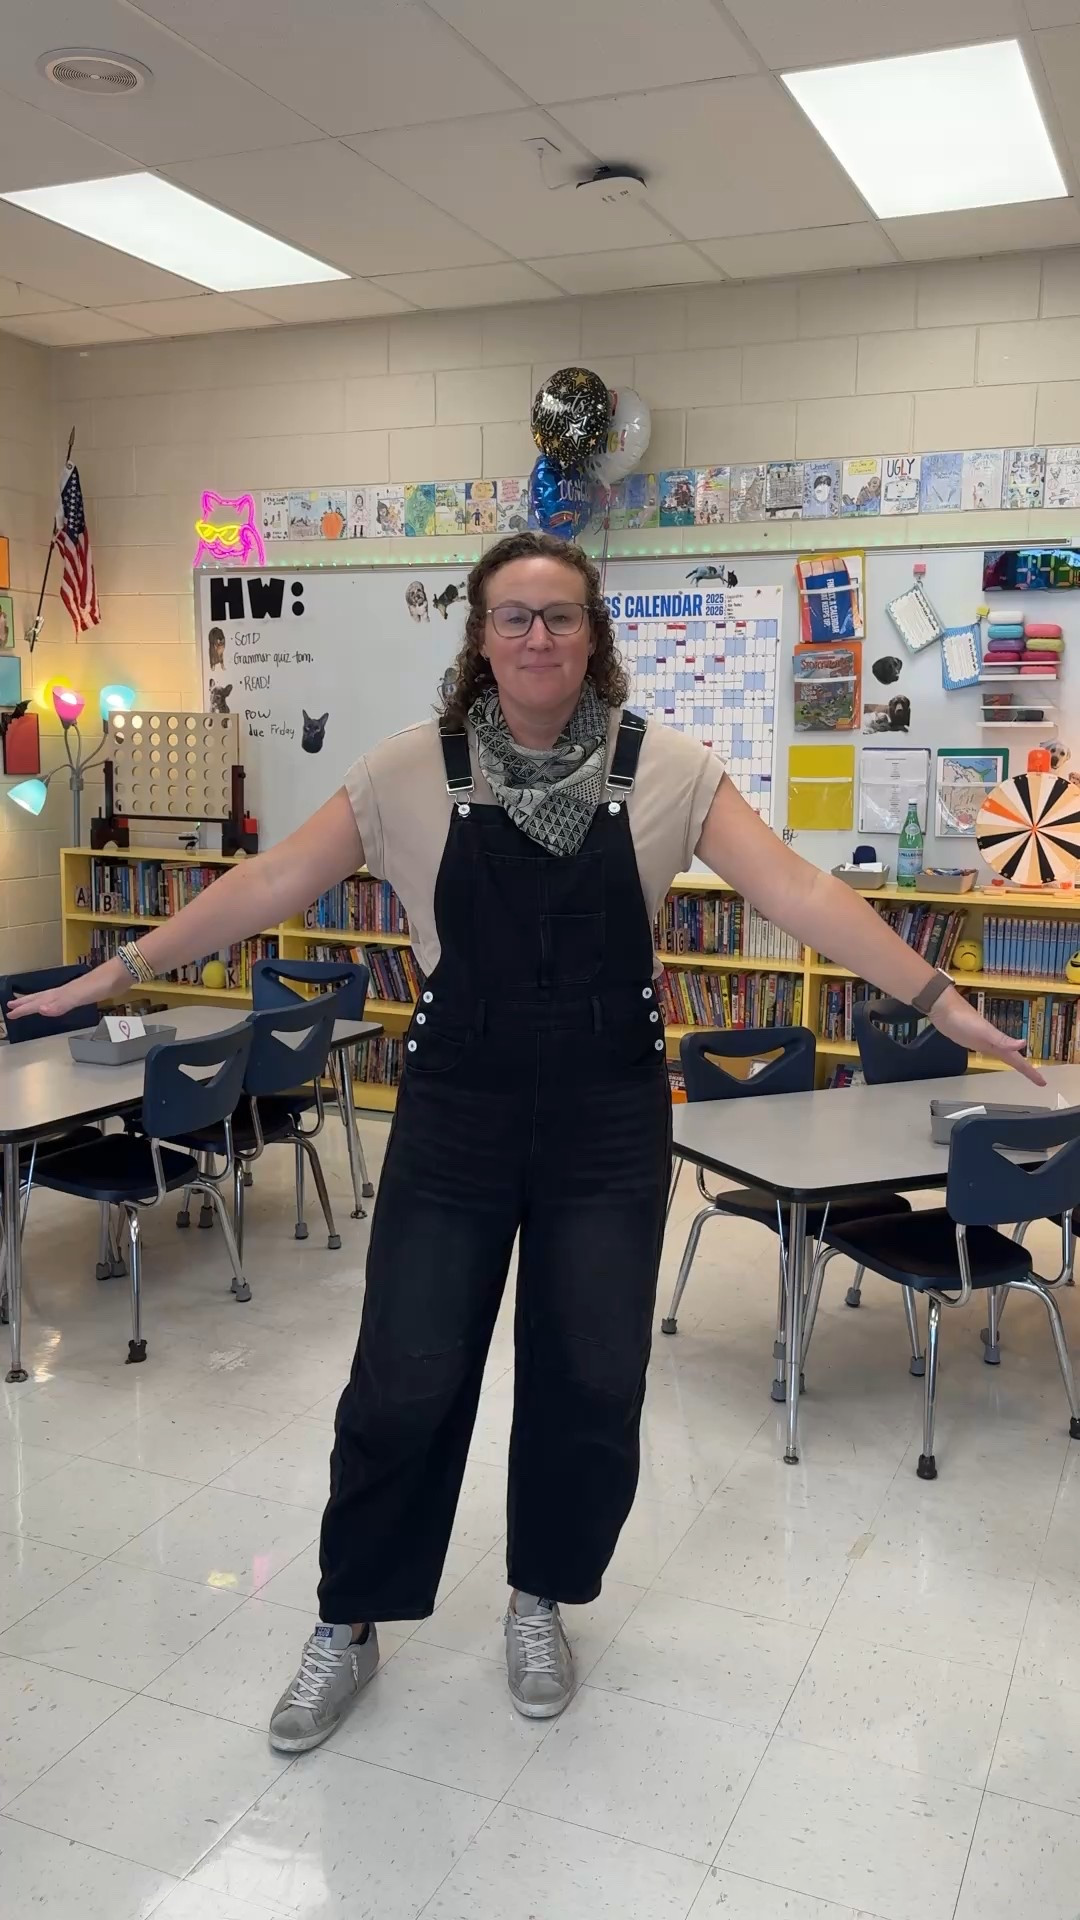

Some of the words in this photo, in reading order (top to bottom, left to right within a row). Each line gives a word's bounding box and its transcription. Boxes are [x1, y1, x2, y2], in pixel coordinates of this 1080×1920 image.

[531, 392, 591, 430] Congrats
[887, 458, 915, 477] UGLY
[210, 577, 305, 621] HW:
[624, 593, 703, 618] CALENDAR
[705, 593, 724, 604] 2025
[705, 605, 724, 616] 2026
[821, 601, 830, 618] KEEPS
[829, 605, 840, 634] CALENDAR
[234, 631, 261, 646] SOTD
[233, 651, 271, 665] Grammar
[273, 651, 291, 667] quiz
[244, 675, 271, 691] READ!
[245, 709, 271, 720] POW
[248, 723, 265, 738] due
[77, 888, 86, 904] A
[103, 895, 112, 912] B
[306, 909, 312, 927] C
[181, 965, 188, 981] I
[192, 967, 199, 984] J
[227, 969, 236, 985] K
